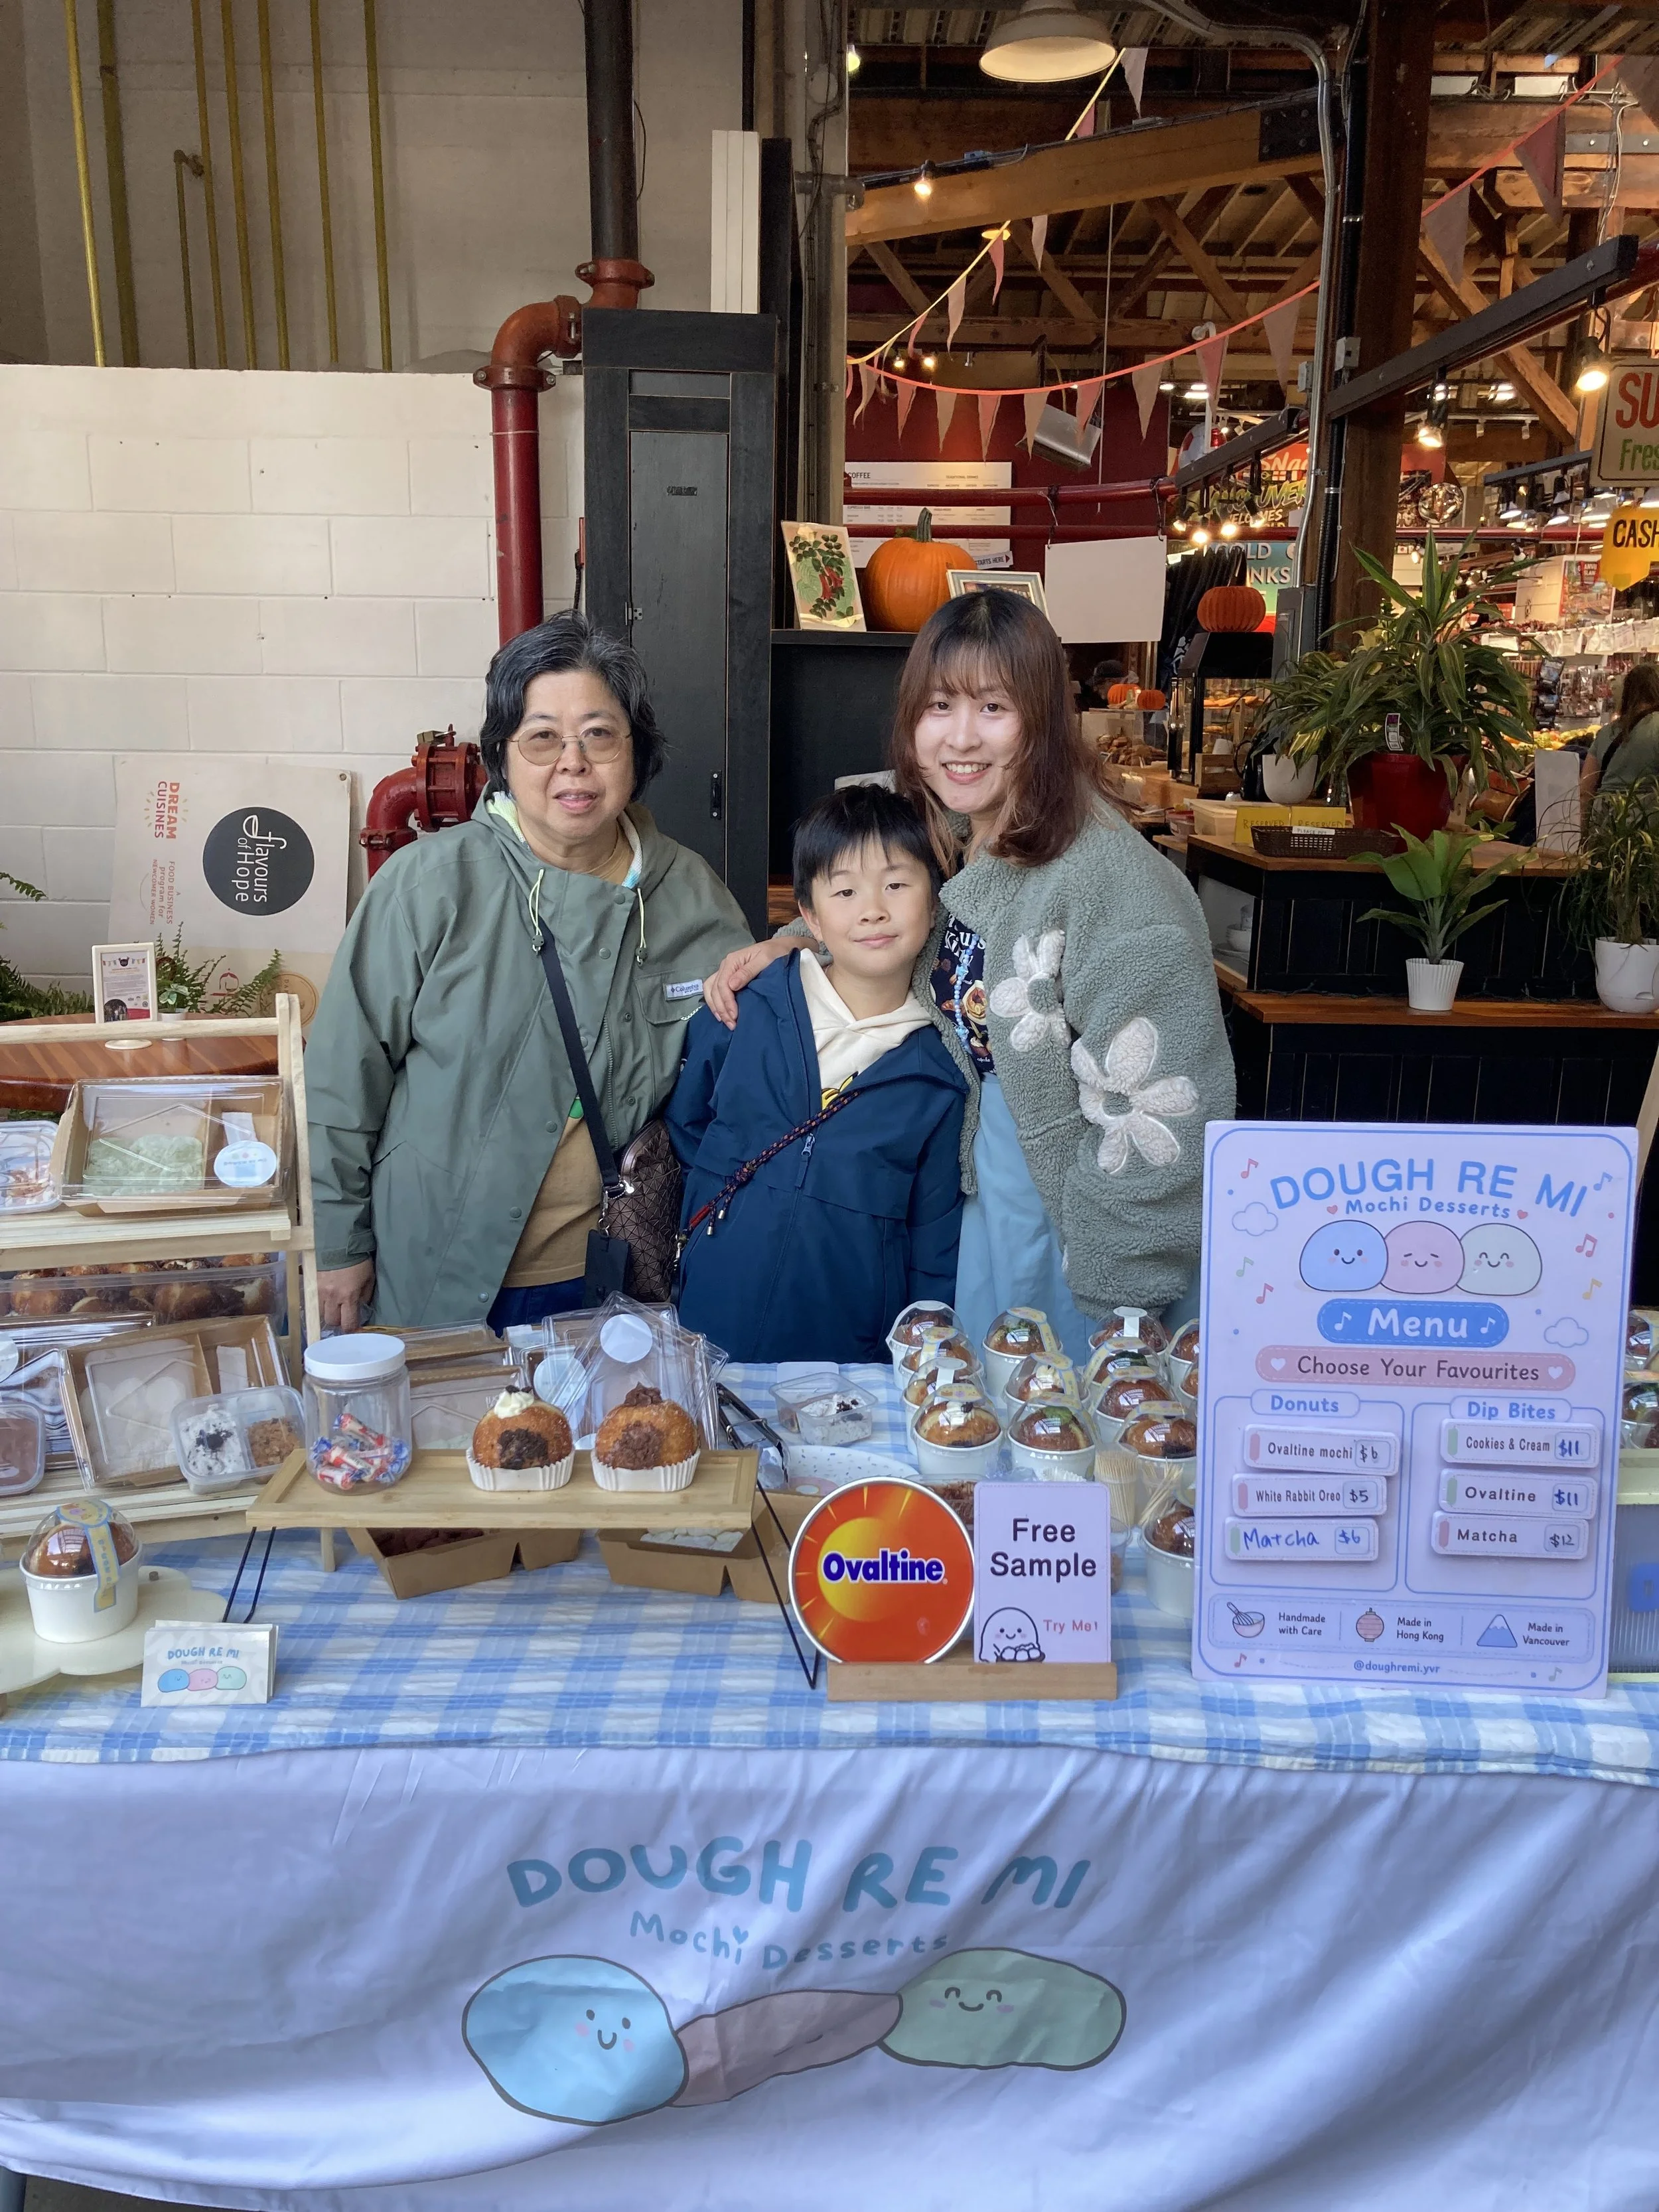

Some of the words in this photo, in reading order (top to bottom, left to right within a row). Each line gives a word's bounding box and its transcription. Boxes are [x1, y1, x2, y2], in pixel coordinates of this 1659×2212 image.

[155, 781, 167, 838] CUISINES
[166, 782, 180, 840] DREAM
[238, 838, 252, 849] of
[243, 815, 287, 903] flavours
[232, 852, 255, 902] Hope
[1269, 1158, 1434, 1209] DOUGH
[1457, 1160, 1518, 1199] RE
[1535, 1173, 1587, 1217] MI
[1346, 1196, 1407, 1215] Mochi
[1419, 1197, 1510, 1218] Desserts
[1368, 1307, 1468, 1339] Menu
[1297, 1355, 1370, 1376] Choose
[1381, 1357, 1427, 1378] Your
[1437, 1359, 1540, 1381] Favourites
[1271, 1395, 1339, 1414] Donuts
[1467, 1401, 1498, 1420] Dip
[1508, 1403, 1555, 1420] Bites
[1268, 1442, 1315, 1457] Ovaltine
[1320, 1447, 1352, 1459] mochi
[1466, 1436, 1504, 1449] Cookies
[1508, 1438, 1515, 1450] &
[1519, 1439, 1550, 1451] Cream
[1558, 1439, 1579, 1457] $11
[1256, 1490, 1282, 1502] White
[1285, 1490, 1315, 1502] Rabbit
[1319, 1489, 1340, 1501] Oreo
[1349, 1489, 1369, 1503] $5
[1465, 1487, 1536, 1502] Ovaltine
[1554, 1489, 1578, 1506] $11
[1013, 1518, 1076, 1543] Free
[1244, 1528, 1319, 1550] Matcha
[1338, 1530, 1360, 1544] $6
[1457, 1528, 1518, 1542] Matcha
[1550, 1533, 1575, 1548] $12
[823, 1549, 944, 1583] Ovaltine
[990, 1552, 1097, 1583] Sample
[1043, 1619, 1066, 1634] Try
[1072, 1619, 1098, 1632] Me!
[1278, 1612, 1325, 1623] Handmade
[1397, 1617, 1421, 1627] Made
[1424, 1618, 1431, 1627] in
[1278, 1626, 1299, 1635] with
[1301, 1626, 1322, 1635] Care
[1396, 1630, 1419, 1642] Hong
[1422, 1631, 1444, 1643] Kong
[1528, 1623, 1552, 1632] Made
[1555, 1623, 1563, 1633] in
[1523, 1635, 1570, 1646] Vancouver
[168, 1647, 205, 1660] DOUGH
[209, 1647, 223, 1657] RE
[226, 1649, 239, 1659] MI
[1354, 1660, 1441, 1675] @doughremi.yvr
[506, 1836, 812, 1912] DOUGH
[843, 1846, 959, 1912] RE
[981, 1856, 1091, 1909] MI
[630, 1910, 749, 1965] Mochi
[763, 1935, 948, 1970] Desserts
